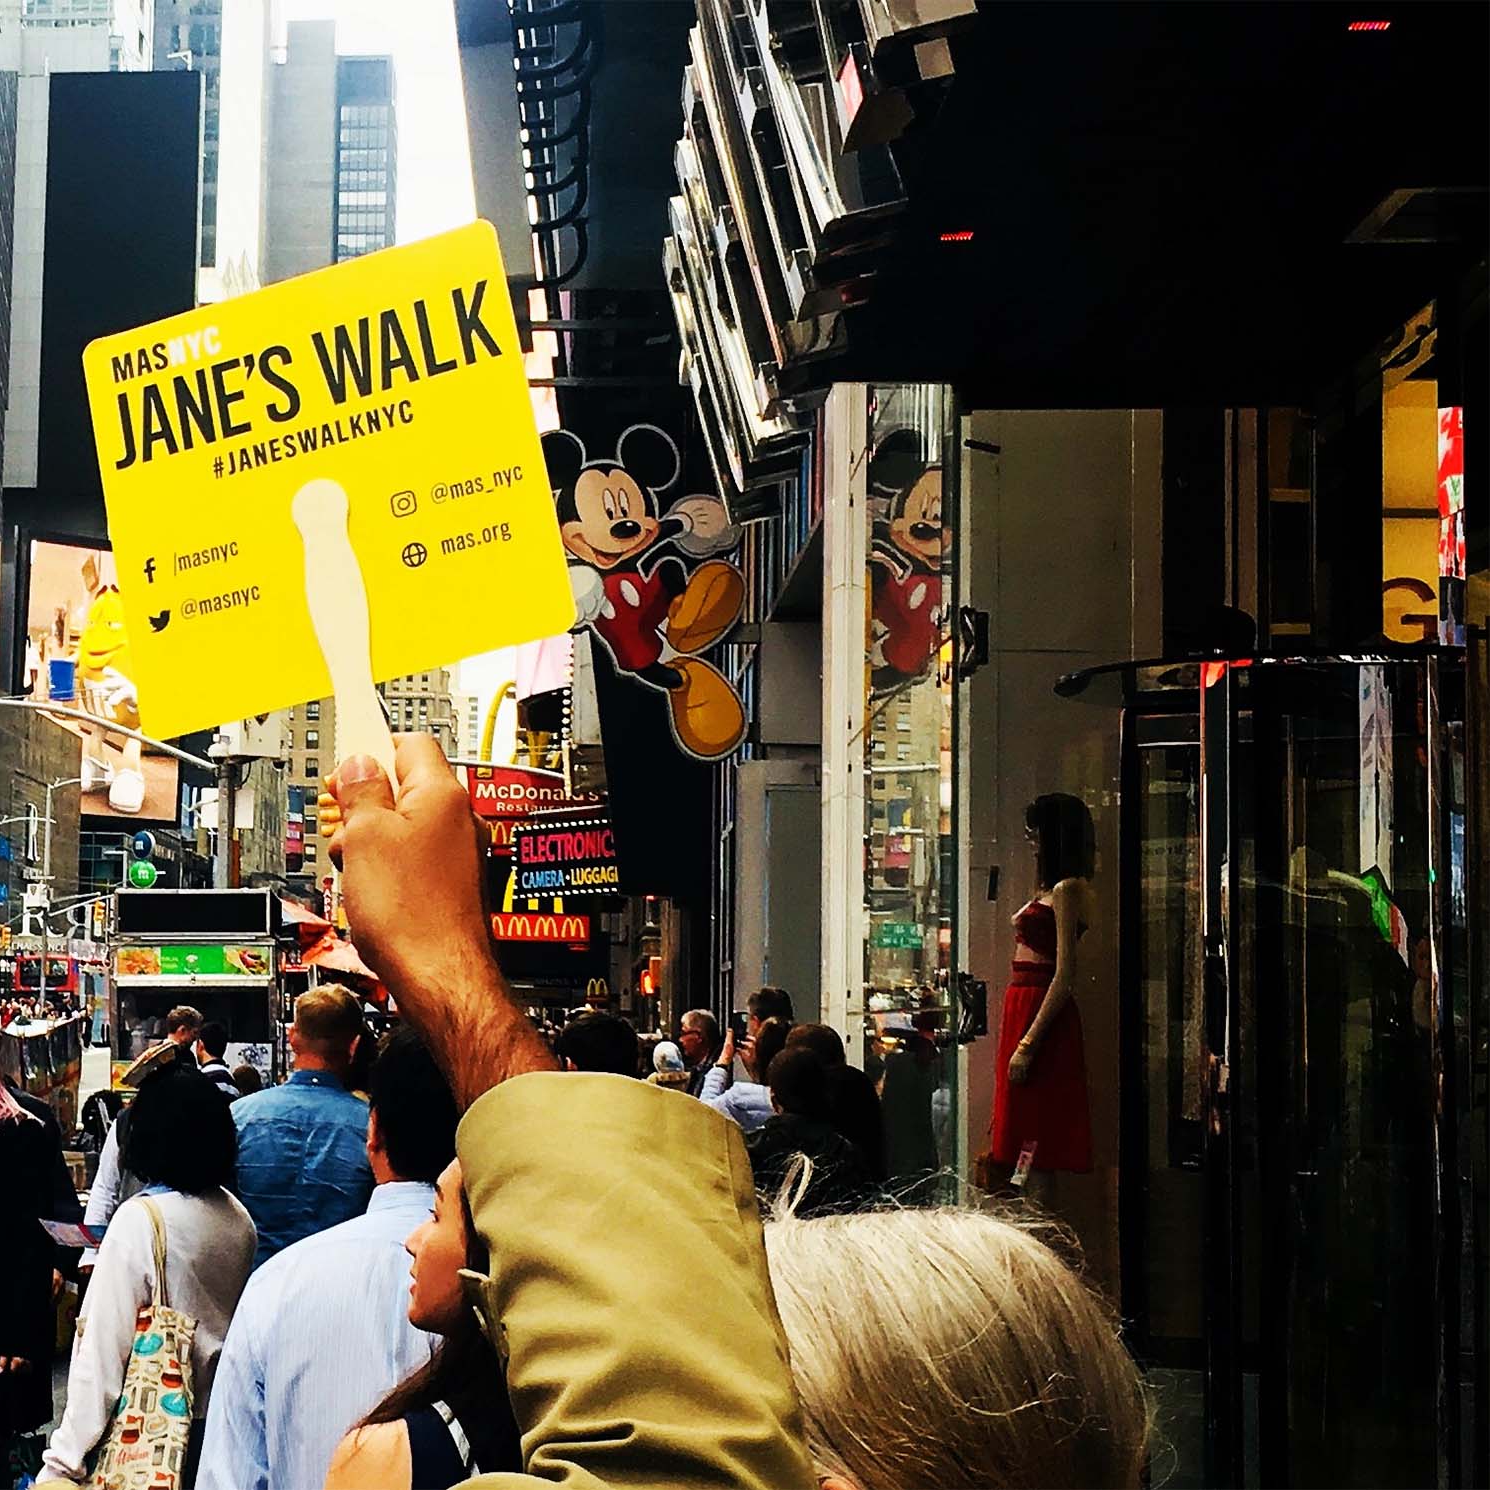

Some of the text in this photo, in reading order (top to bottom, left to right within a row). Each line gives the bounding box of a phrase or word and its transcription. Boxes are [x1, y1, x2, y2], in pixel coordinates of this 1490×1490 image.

[111, 325, 222, 383] MASNYC
[115, 279, 502, 470] JANE'S WALK
[212, 399, 415, 479] #JANESWALKNYC
[430, 463, 524, 504] @mas_nyc
[440, 520, 512, 556] mas.org
[173, 539, 240, 576] /masnyc
[180, 584, 261, 620] @masnyc
[520, 830, 616, 864] ELECTRONIC
[521, 869, 565, 889] CAMERA
